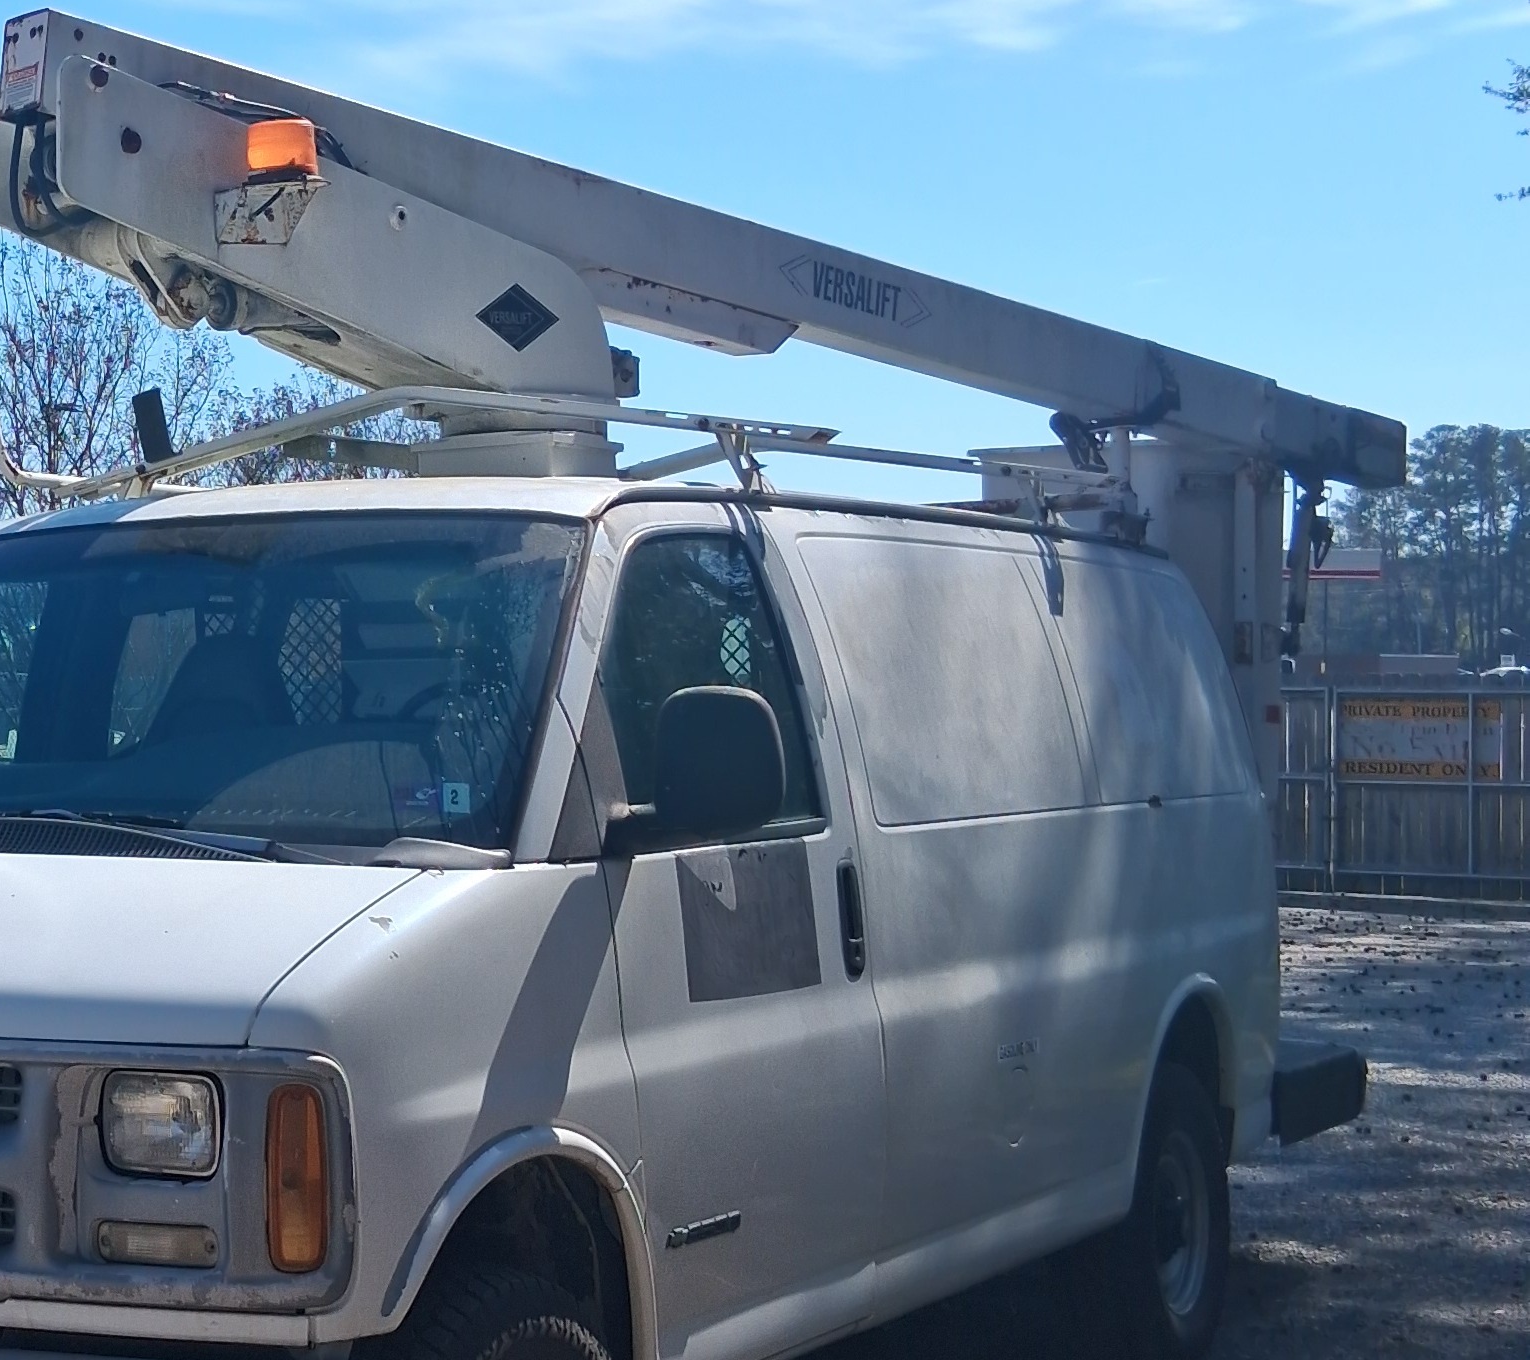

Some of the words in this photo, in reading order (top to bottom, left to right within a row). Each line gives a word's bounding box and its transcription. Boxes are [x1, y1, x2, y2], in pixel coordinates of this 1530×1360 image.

[812, 260, 902, 322] VERSALIFT
[1342, 704, 1402, 717] PRIVATE
[1412, 705, 1490, 718] PROPERY
[1345, 761, 1432, 776] RESIDENT
[1441, 763, 1491, 777] ONY
[450, 788, 459, 805] 2
